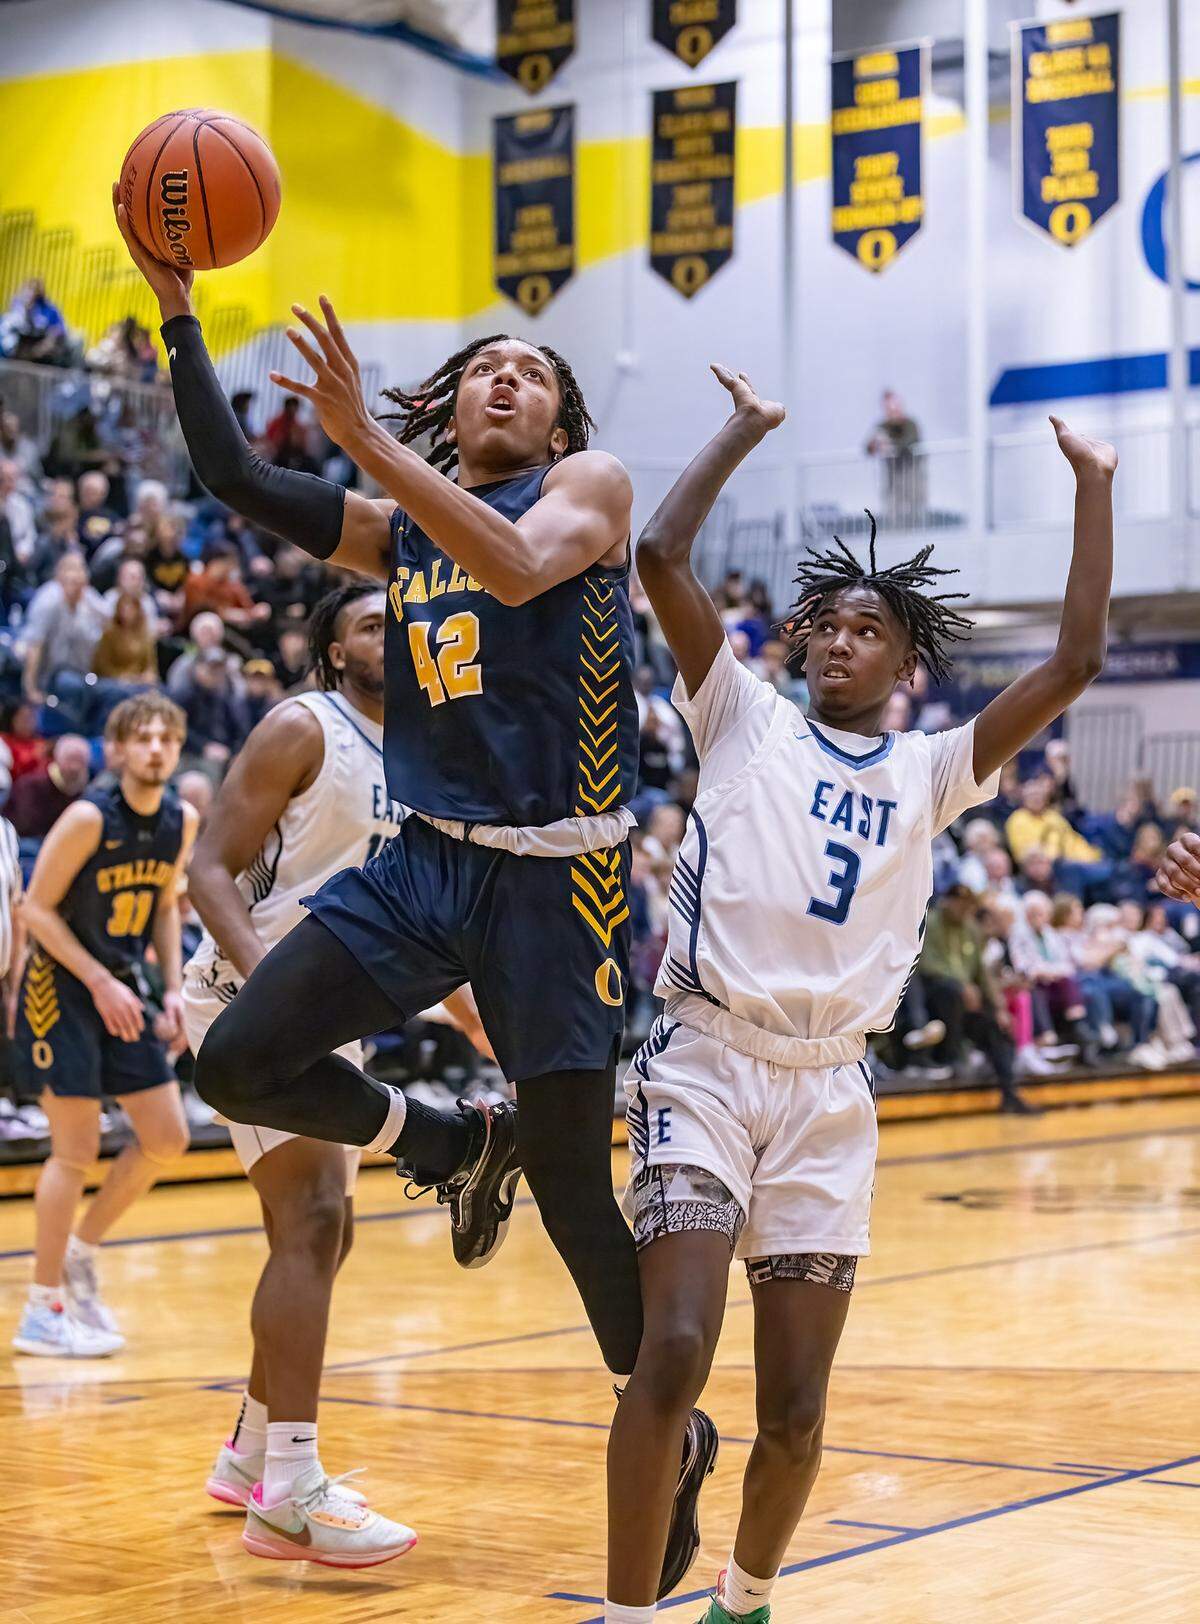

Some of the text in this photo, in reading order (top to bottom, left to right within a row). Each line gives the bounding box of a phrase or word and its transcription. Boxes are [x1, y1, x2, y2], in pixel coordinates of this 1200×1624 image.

[160, 168, 195, 266] Wilson
[1048, 201, 1092, 244] O
[856, 229, 898, 269] O
[407, 610, 484, 708] 42
[809, 778, 898, 848] EAST
[805, 838, 862, 927] 3
[594, 957, 624, 1007] O
[31, 1040, 55, 1070] O
[657, 1106, 673, 1146] E
